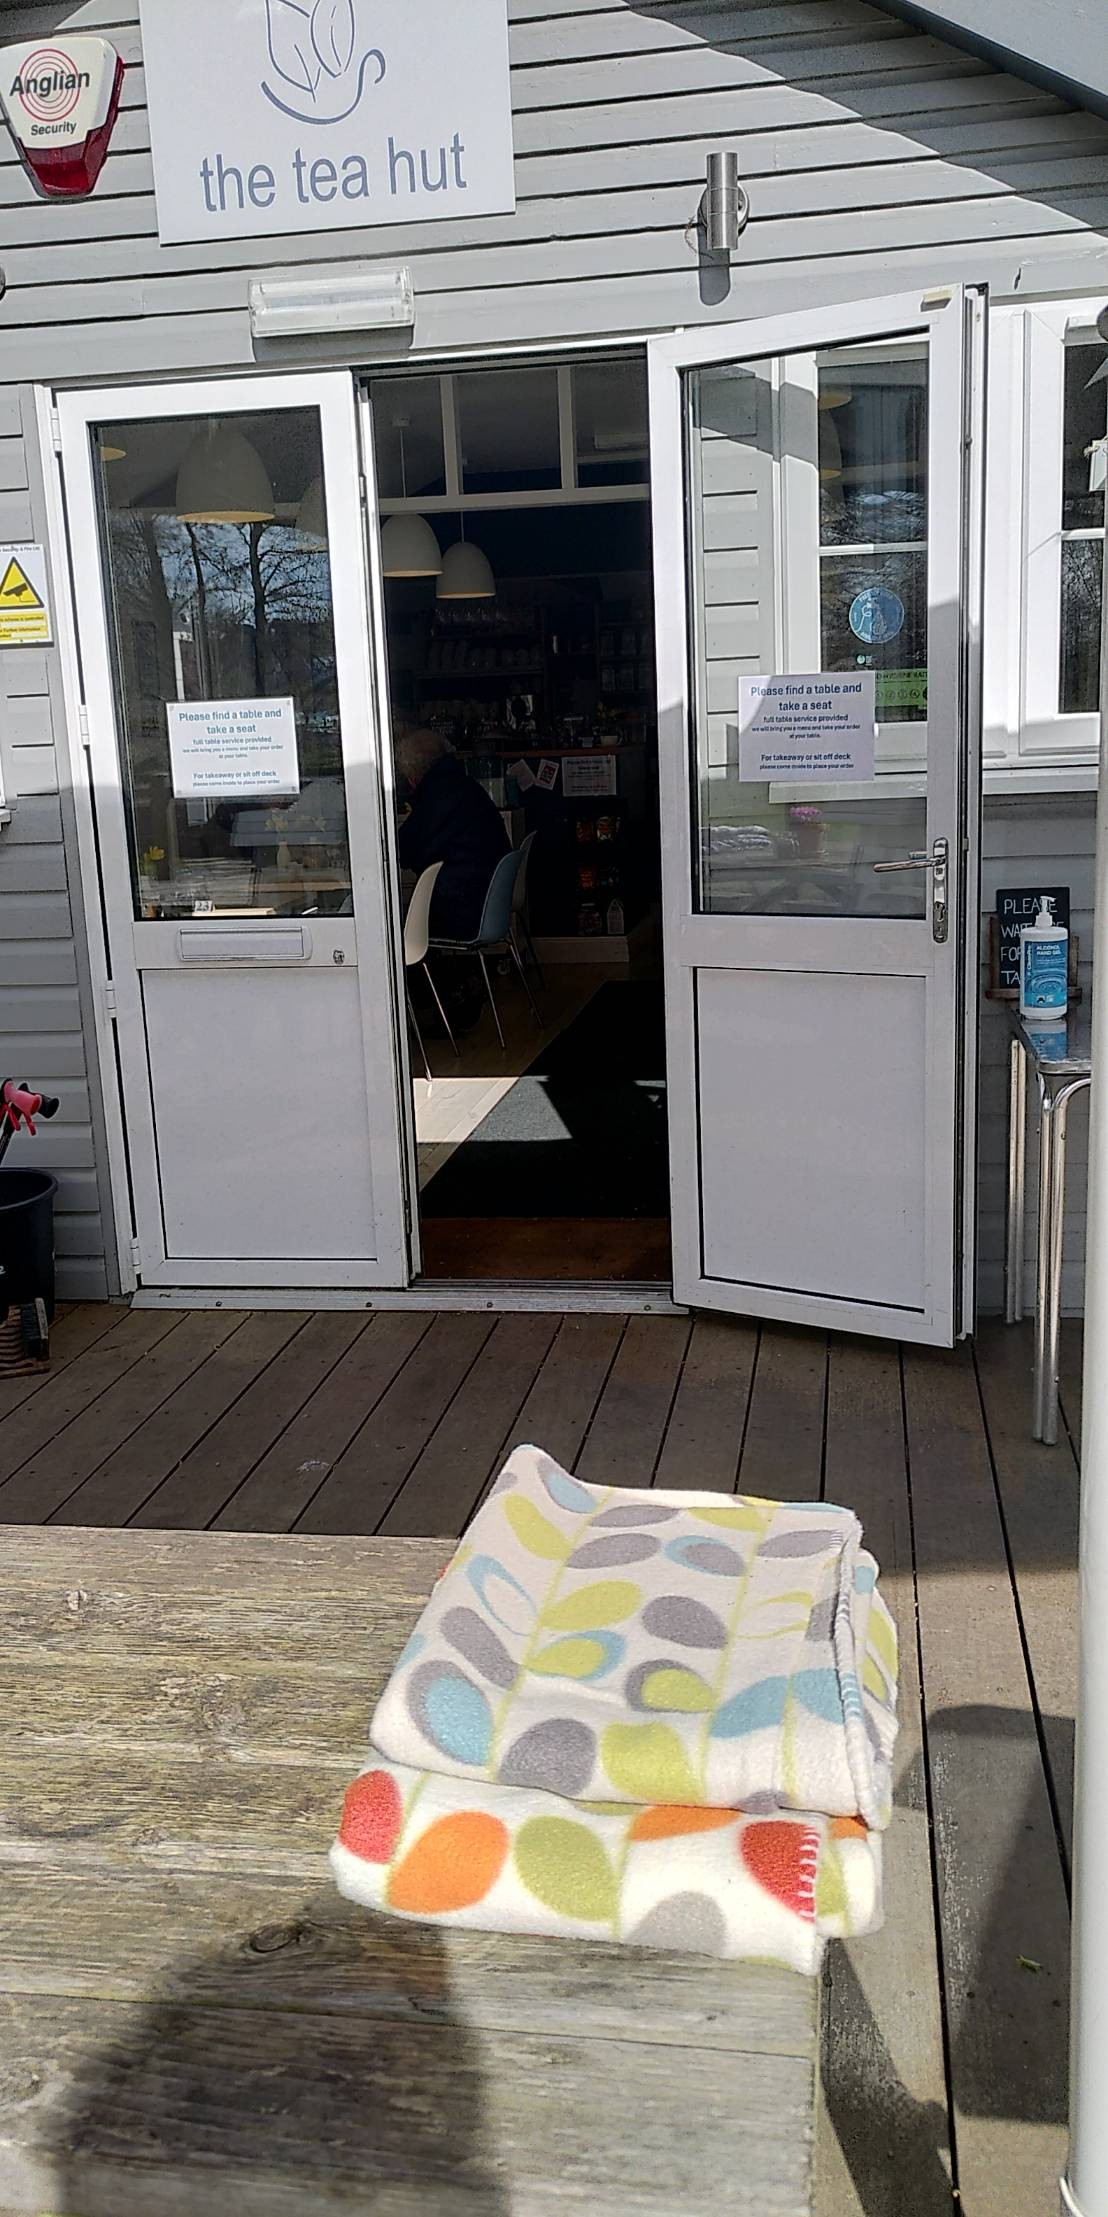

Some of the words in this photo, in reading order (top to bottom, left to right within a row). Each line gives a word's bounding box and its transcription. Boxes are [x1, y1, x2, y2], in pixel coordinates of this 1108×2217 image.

[9, 70, 90, 97] Anglian
[30, 120, 76, 136] Security
[200, 153, 275, 212] the
[292, 147, 369, 204] tea
[387, 132, 467, 195] hut
[751, 686, 783, 696] Please
[786, 685, 804, 694] find
[815, 684, 840, 694] table
[843, 683, 862, 692] and
[779, 702, 799, 711] take
[810, 701, 832, 709] seat
[179, 712, 210, 721] Please
[212, 711, 230, 720] find
[239, 710, 262, 719] table
[265, 709, 281, 718] and
[207, 726, 226, 734] take
[237, 724, 256, 732] seat
